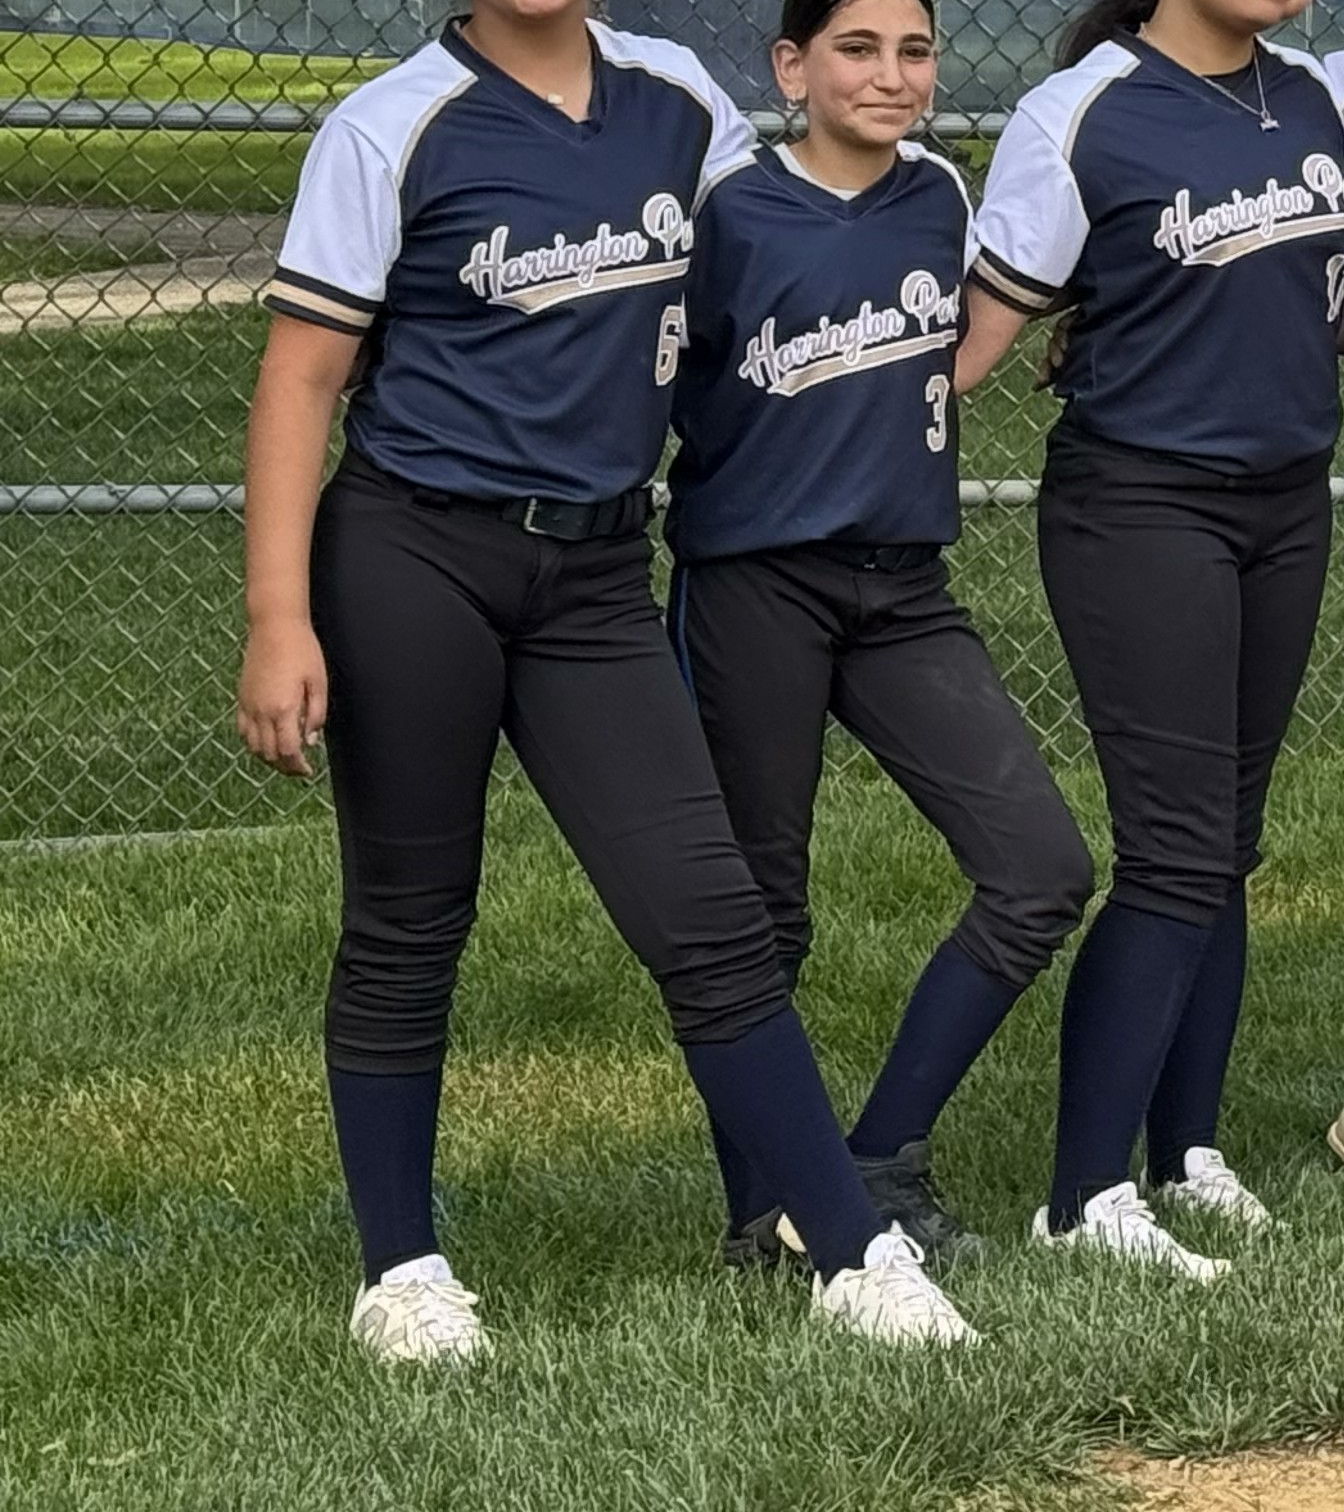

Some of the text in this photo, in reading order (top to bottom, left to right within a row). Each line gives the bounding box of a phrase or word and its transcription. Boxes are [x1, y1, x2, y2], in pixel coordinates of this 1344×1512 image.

[459, 192, 694, 299] Harrington Pa
[1154, 178, 1314, 260] Harrington
[655, 305, 684, 386] 6
[738, 300, 906, 389] Harrington
[925, 374, 951, 453] 3
